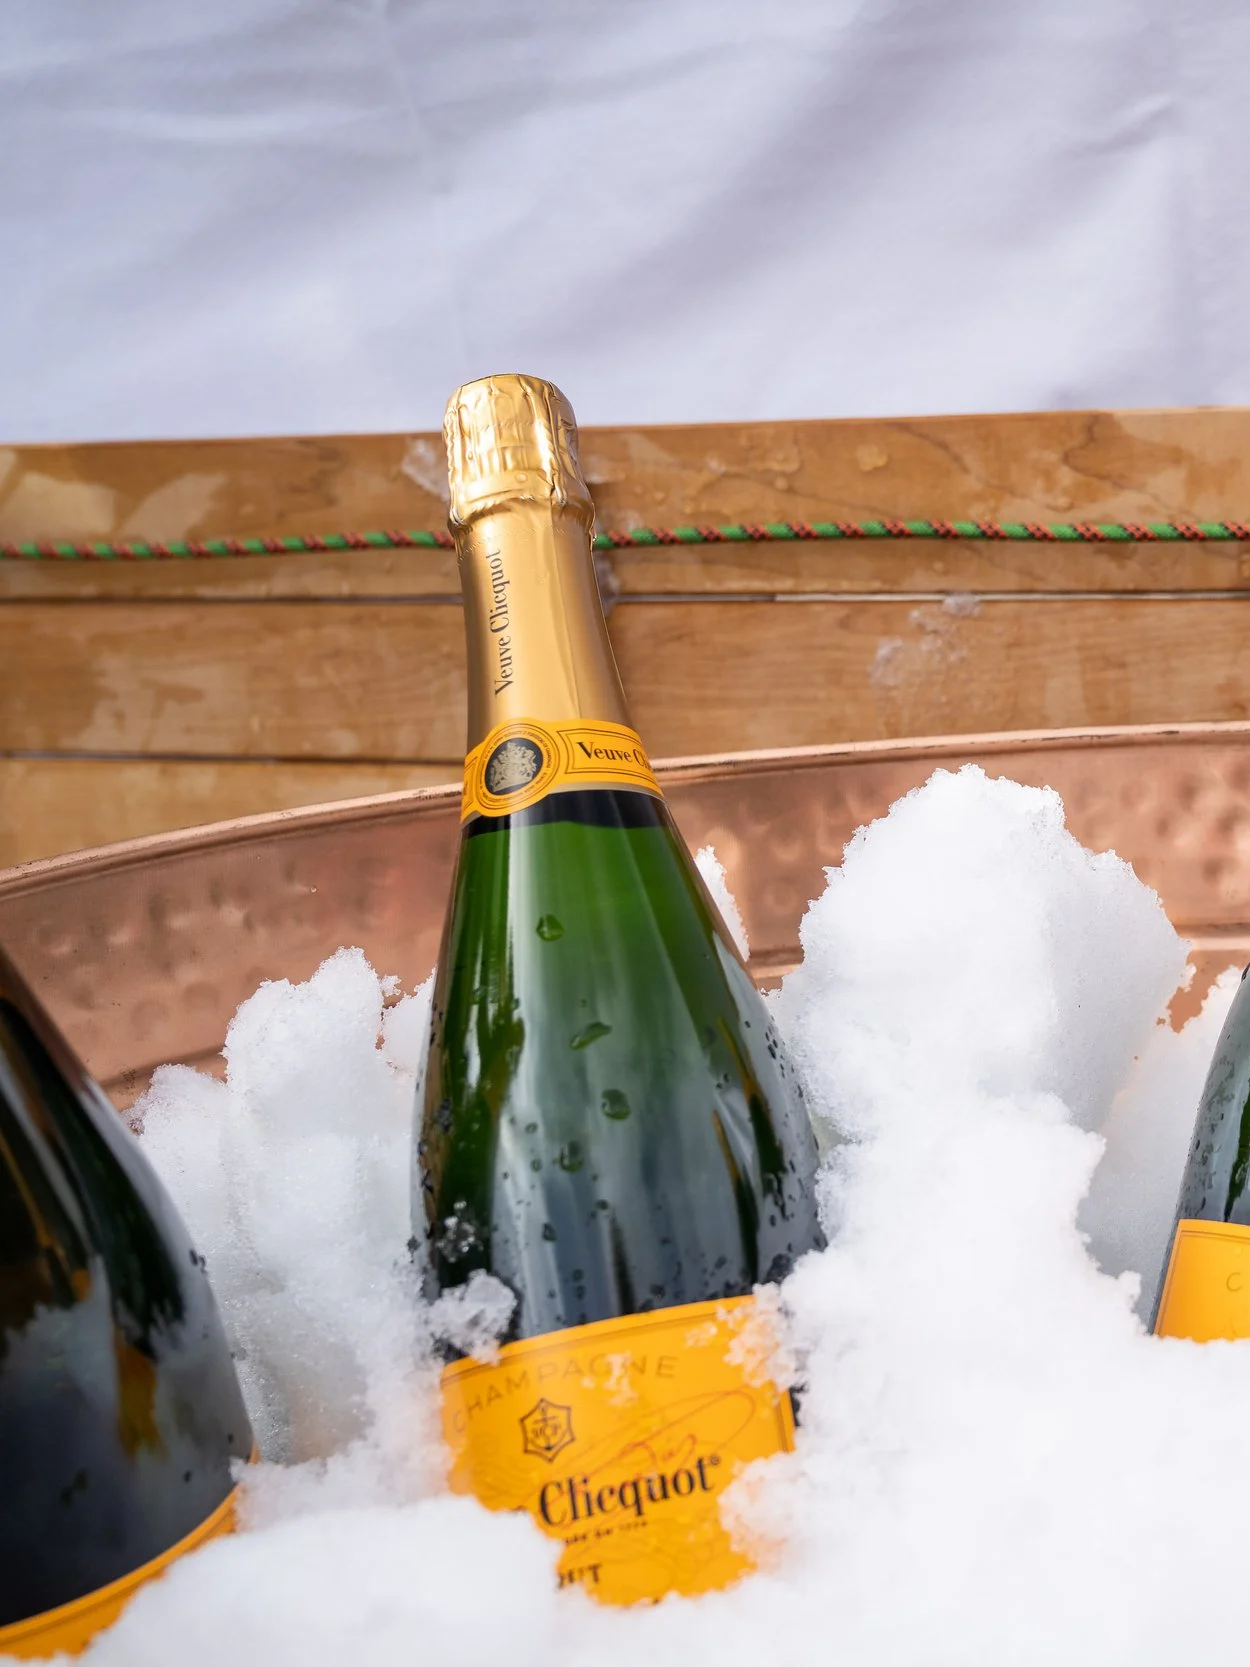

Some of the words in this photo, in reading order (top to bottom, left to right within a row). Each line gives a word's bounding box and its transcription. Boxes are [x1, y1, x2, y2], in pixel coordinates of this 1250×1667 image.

[486, 547, 511, 634] Clicquot
[494, 634, 514, 698] Veuve
[576, 741, 632, 763] Veuve
[452, 1354, 679, 1434] CHAMPAGNE
